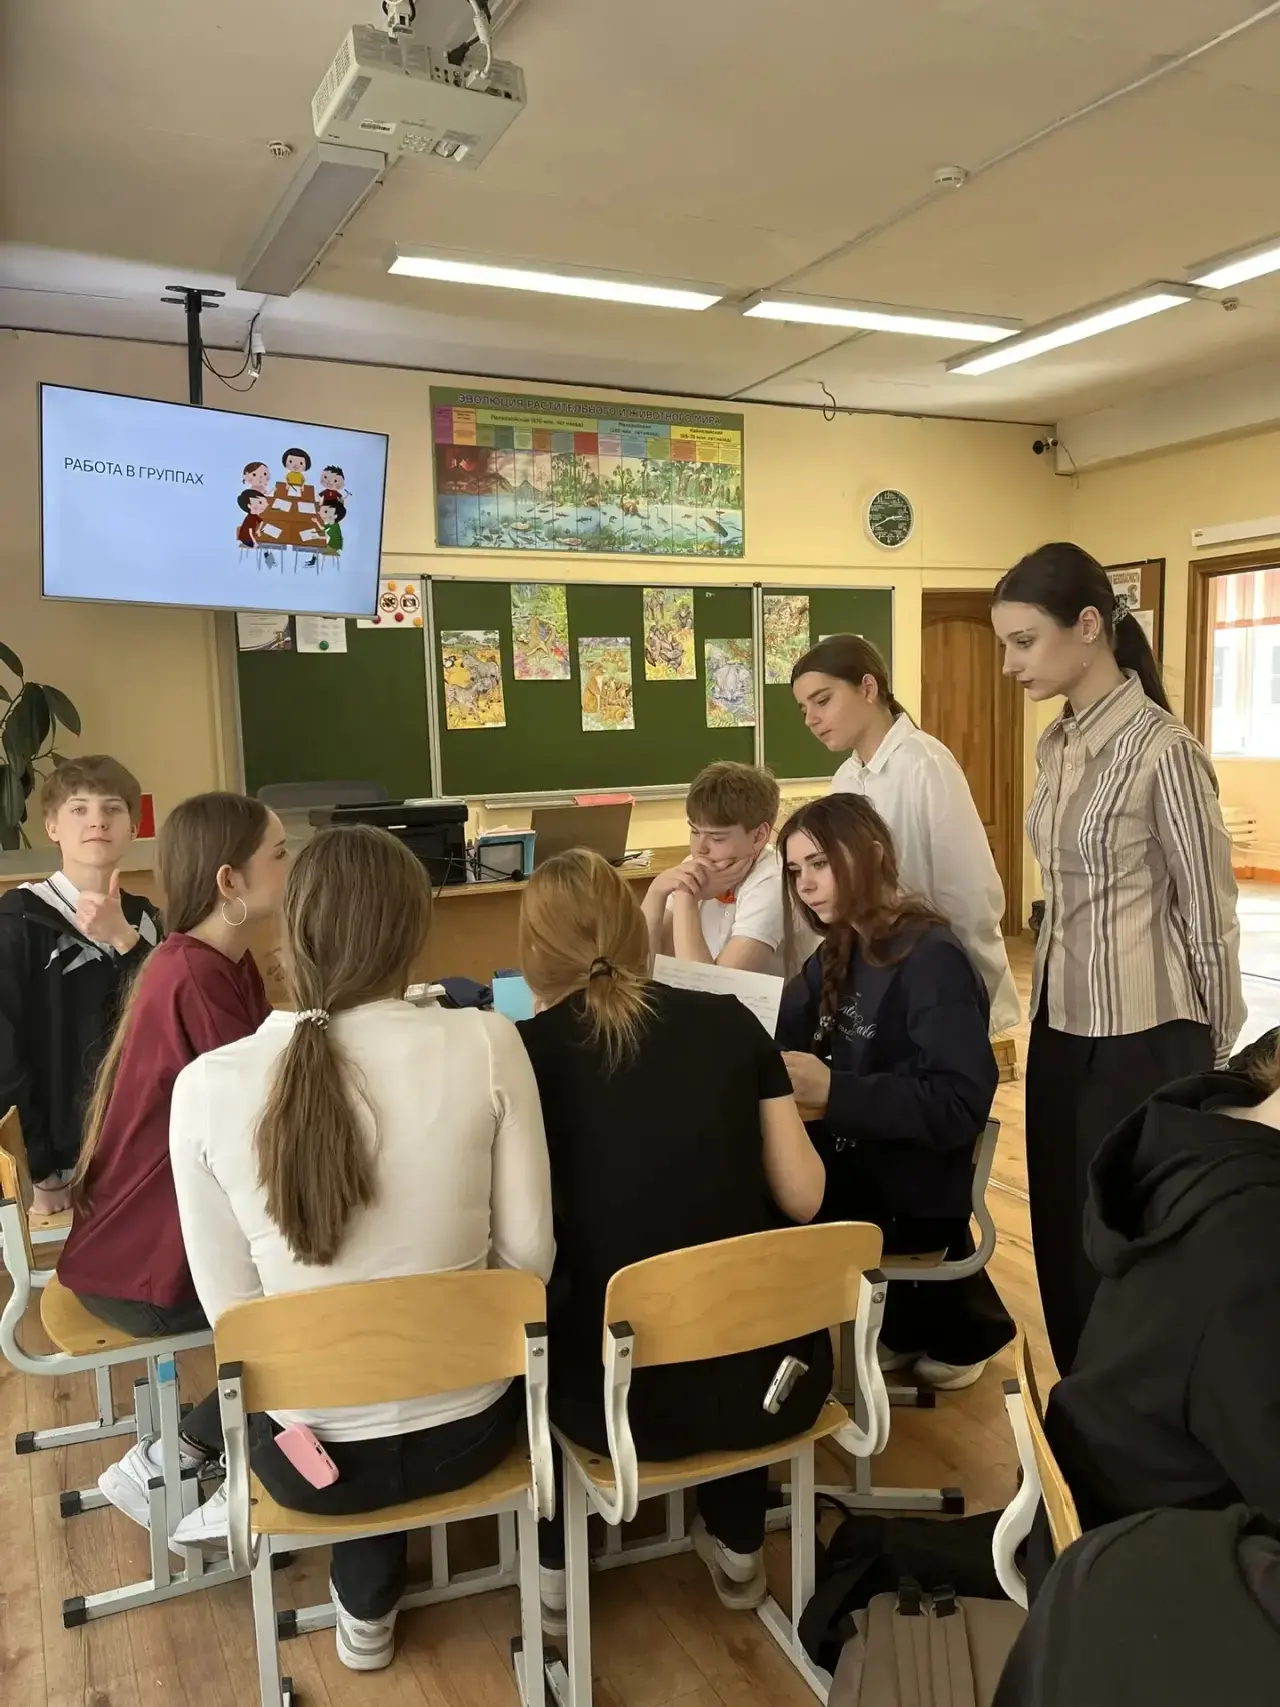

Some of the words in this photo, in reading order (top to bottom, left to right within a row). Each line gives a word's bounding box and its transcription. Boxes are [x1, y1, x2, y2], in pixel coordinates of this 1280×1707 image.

[458, 393, 524, 408] ЭВОЛЮЦИЯ
[527, 400, 616, 416] РАСТИТЕЛЬНОГО
[619, 408, 626, 416] И
[628, 409, 692, 423] ЖИВОТНОГО
[694, 415, 721, 425] МИРА
[64, 457, 123, 476] РАБОТА
[126, 464, 136, 477] В
[139, 466, 204, 485] ГРУППАХ
